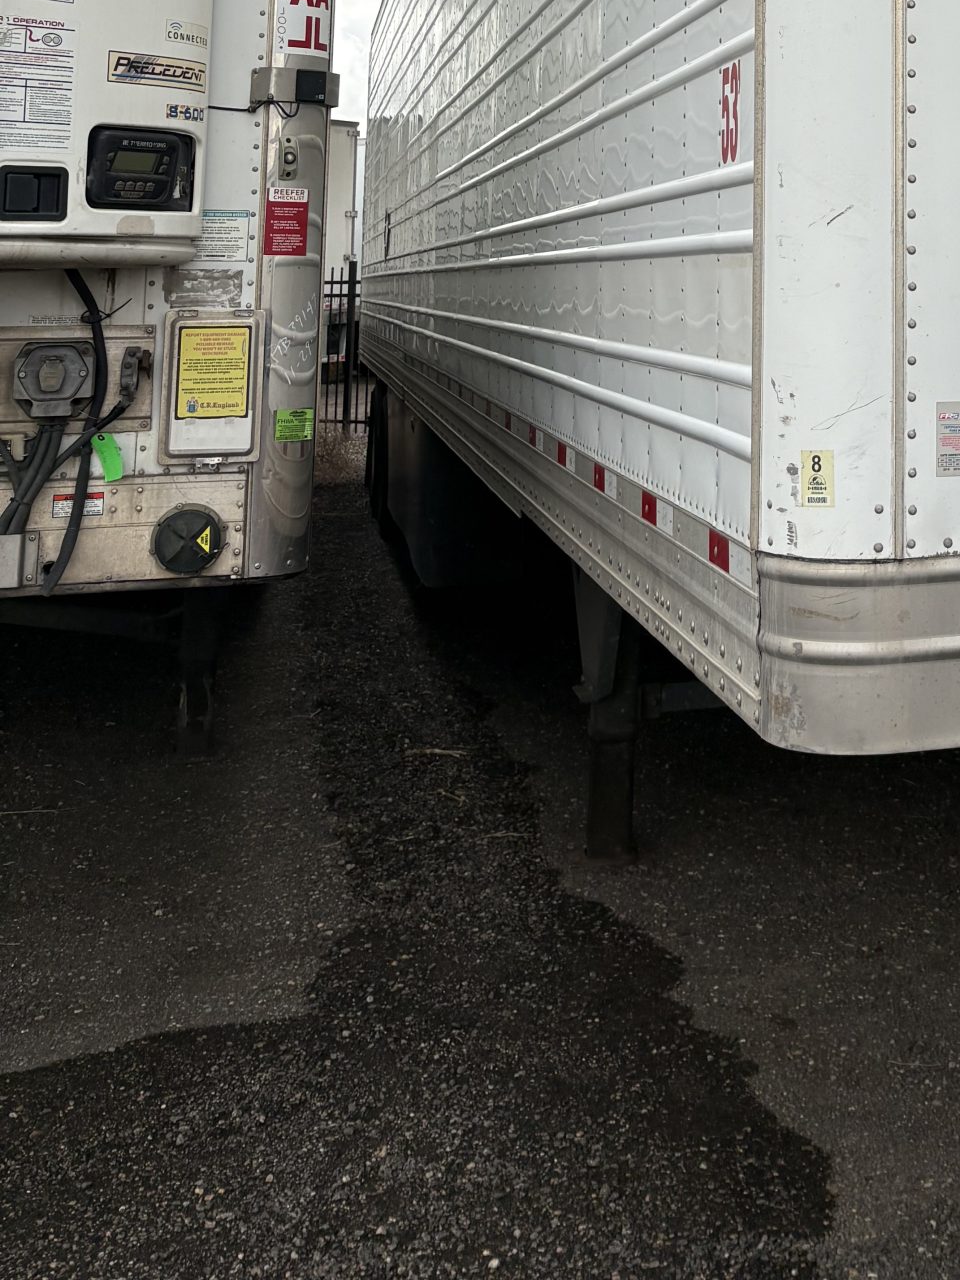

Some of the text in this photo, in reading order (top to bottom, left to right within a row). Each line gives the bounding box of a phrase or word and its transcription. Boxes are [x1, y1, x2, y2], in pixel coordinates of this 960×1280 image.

[13, 17, 65, 27] OPERATION
[113, 56, 205, 82] PRECEDENT
[273, 188, 305, 196] REEFER
[811, 454, 822, 473] 8
